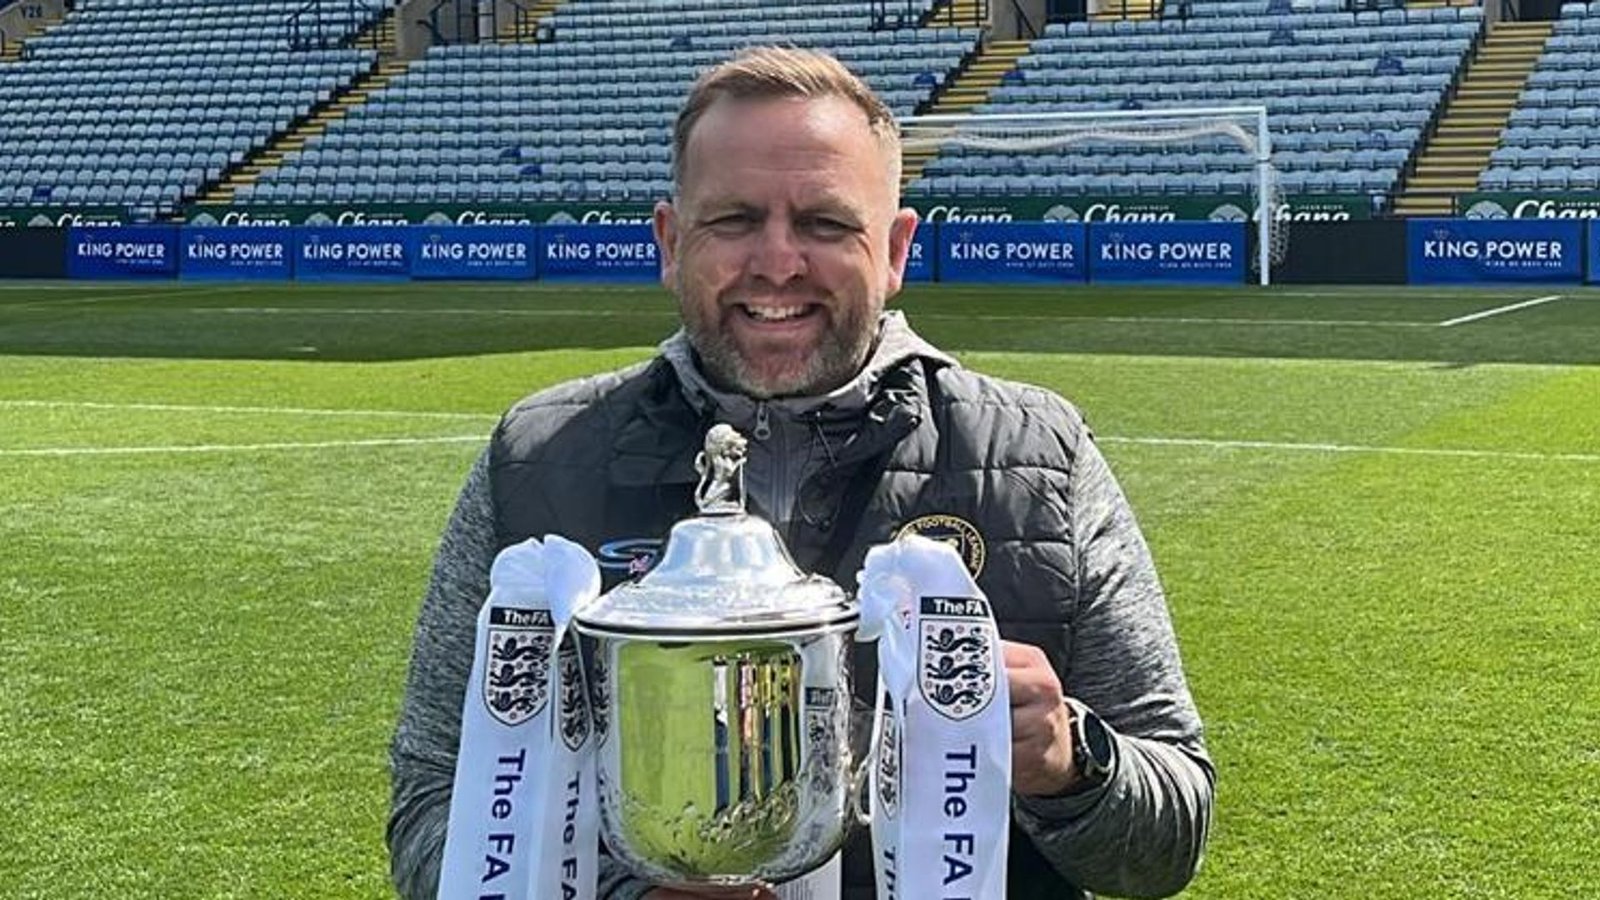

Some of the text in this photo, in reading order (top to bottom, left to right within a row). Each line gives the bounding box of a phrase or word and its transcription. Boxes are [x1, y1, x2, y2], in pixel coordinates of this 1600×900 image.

[1513, 200, 1600, 219] Chan
[77, 243, 165, 258] KING POWER
[188, 243, 283, 259] KING POWER
[303, 243, 403, 259] KING POWER
[422, 243, 526, 259] KING POWER
[547, 243, 656, 259] KING POWER
[951, 243, 1073, 259] KING POWER
[1101, 243, 1232, 260] KING POWER
[1424, 240, 1562, 259] KING POWER
[492, 748, 526, 819] The
[944, 744, 976, 818] The
[481, 833, 515, 883] FA
[943, 833, 973, 886] FA
